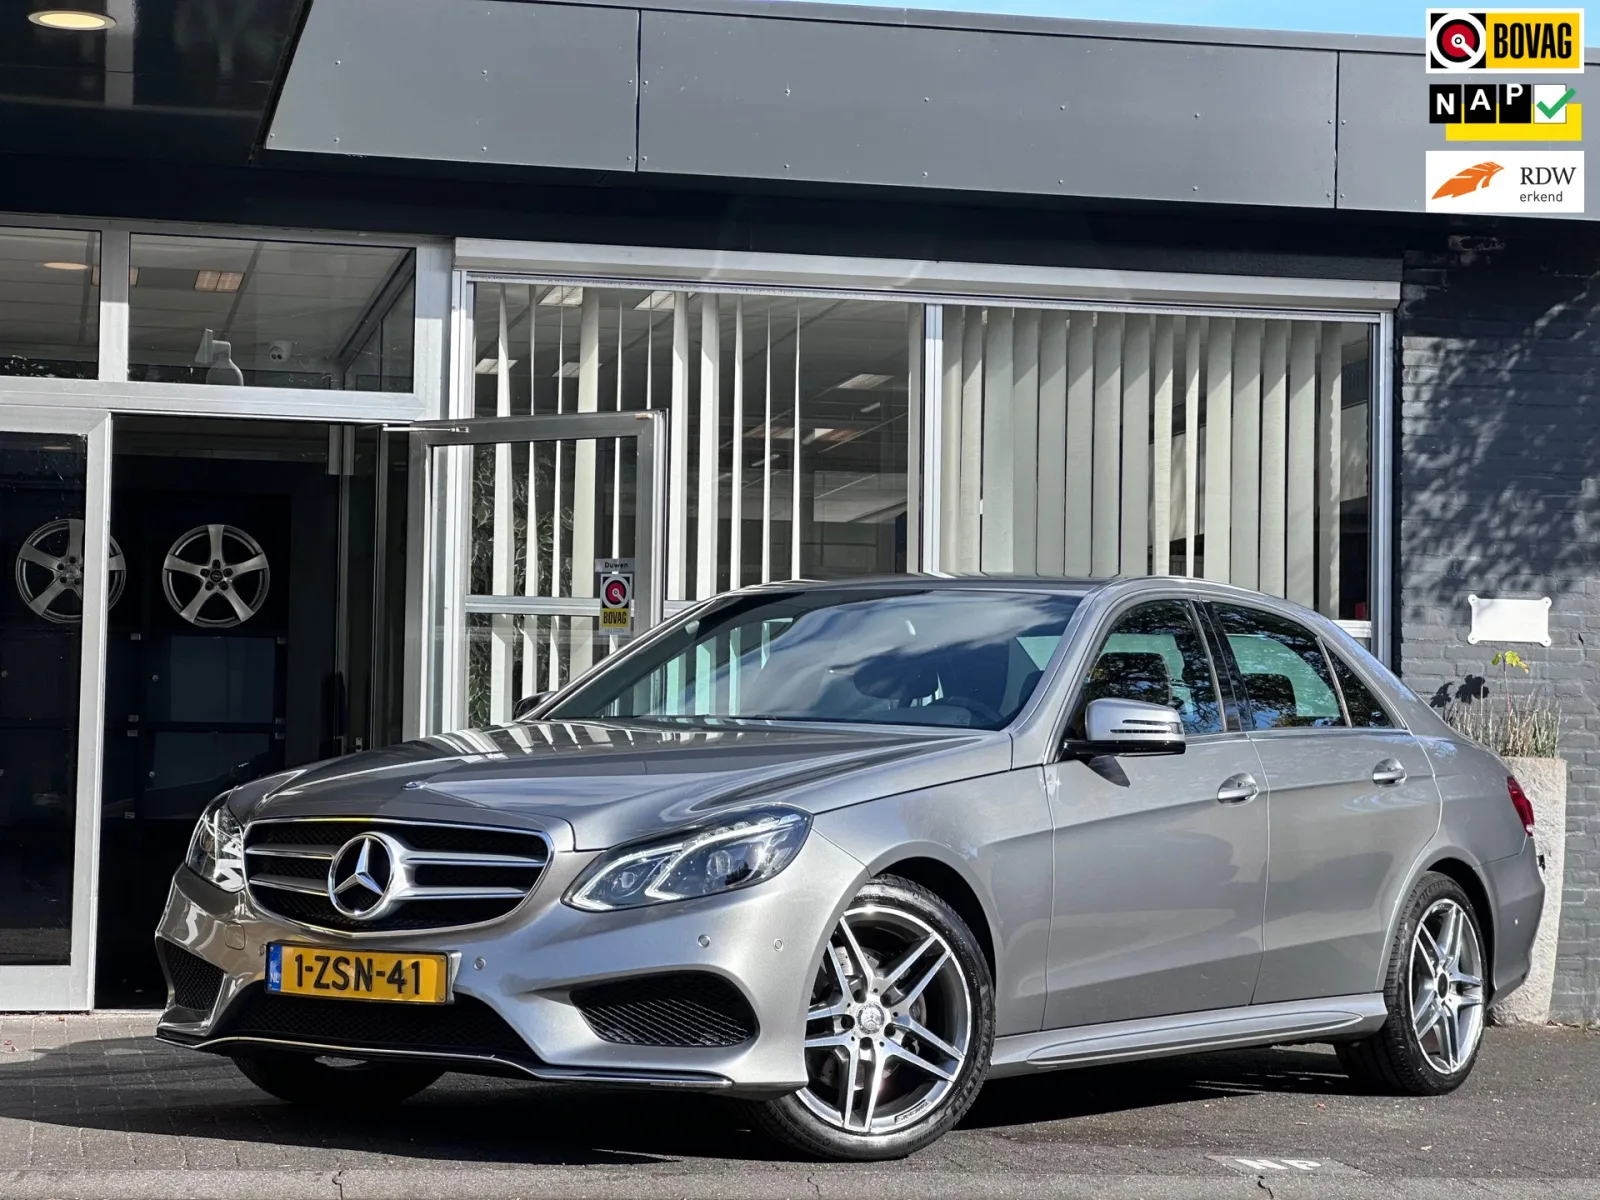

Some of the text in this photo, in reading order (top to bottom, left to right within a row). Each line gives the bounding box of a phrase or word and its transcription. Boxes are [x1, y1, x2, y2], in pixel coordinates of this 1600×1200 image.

[603, 611, 627, 624] BOVAG
[269, 972, 280, 983] NL
[294, 953, 421, 995] 1-ZSN-41
